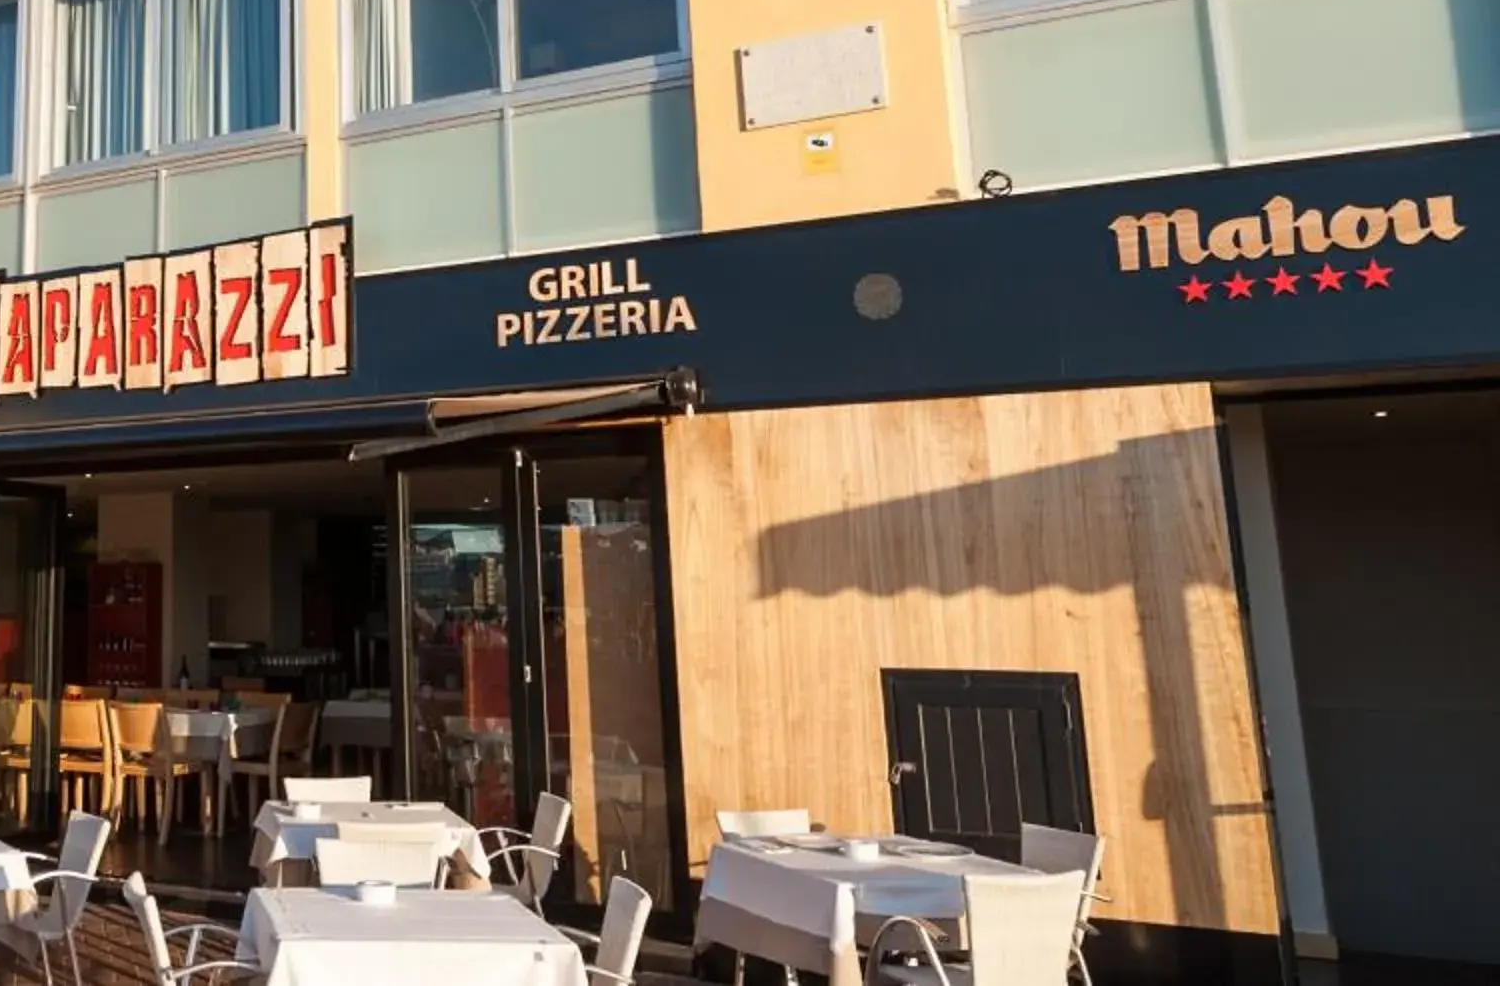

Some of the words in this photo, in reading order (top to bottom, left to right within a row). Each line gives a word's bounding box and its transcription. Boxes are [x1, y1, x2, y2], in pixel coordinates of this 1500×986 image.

[1108, 195, 1466, 271] Mahou
[528, 258, 651, 302] GRILL
[496, 295, 698, 347] PIZZERIA
